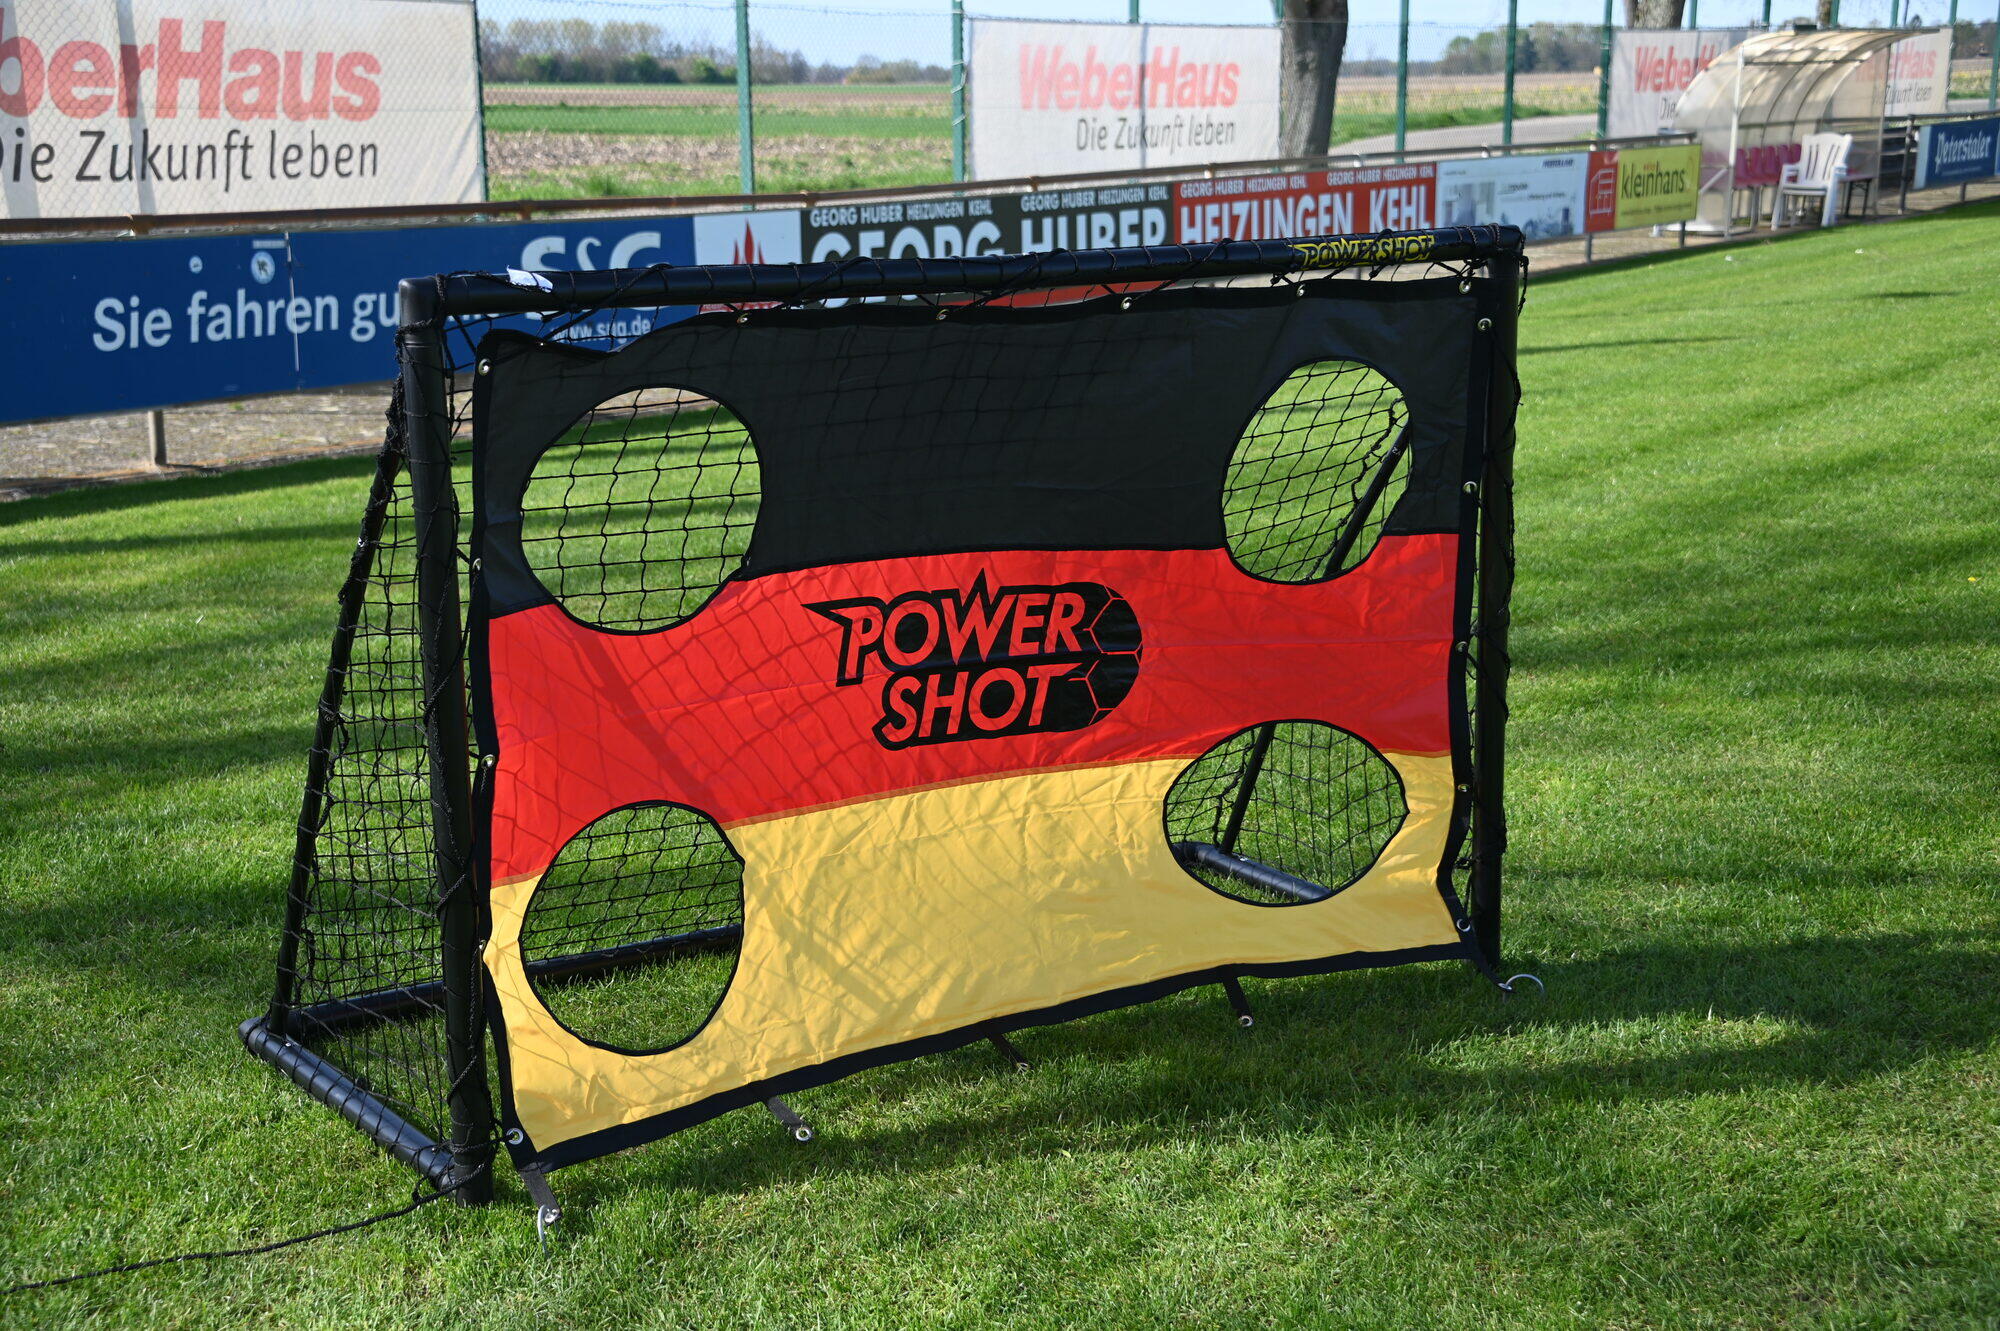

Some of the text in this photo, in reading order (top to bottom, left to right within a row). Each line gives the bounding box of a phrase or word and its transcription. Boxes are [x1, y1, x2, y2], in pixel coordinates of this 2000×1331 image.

[1019, 44, 1241, 111] WeberHaus
[1076, 114, 1235, 155] Die Zukunft leben
[1935, 130, 1991, 174] Peterstaler
[0, 127, 379, 193] ie Zukunft leben
[1327, 165, 1434, 187] GEORG HUBER HEIZUNGEN KEHL
[1621, 160, 1685, 199] kleinhans
[1020, 185, 1169, 212] GEORG HUBER HEIZUNGEN KEHL
[1180, 175, 1307, 198] GEORG HUBER HEIZUNGEN KEHL
[810, 199, 993, 228] GEORG HUBER HEIZUNGEN KEHL
[1369, 185, 1435, 235] KEHL
[93, 288, 402, 352] Sie fahren gu
[826, 584, 1088, 682] POWER
[880, 661, 1085, 744] SHOT
